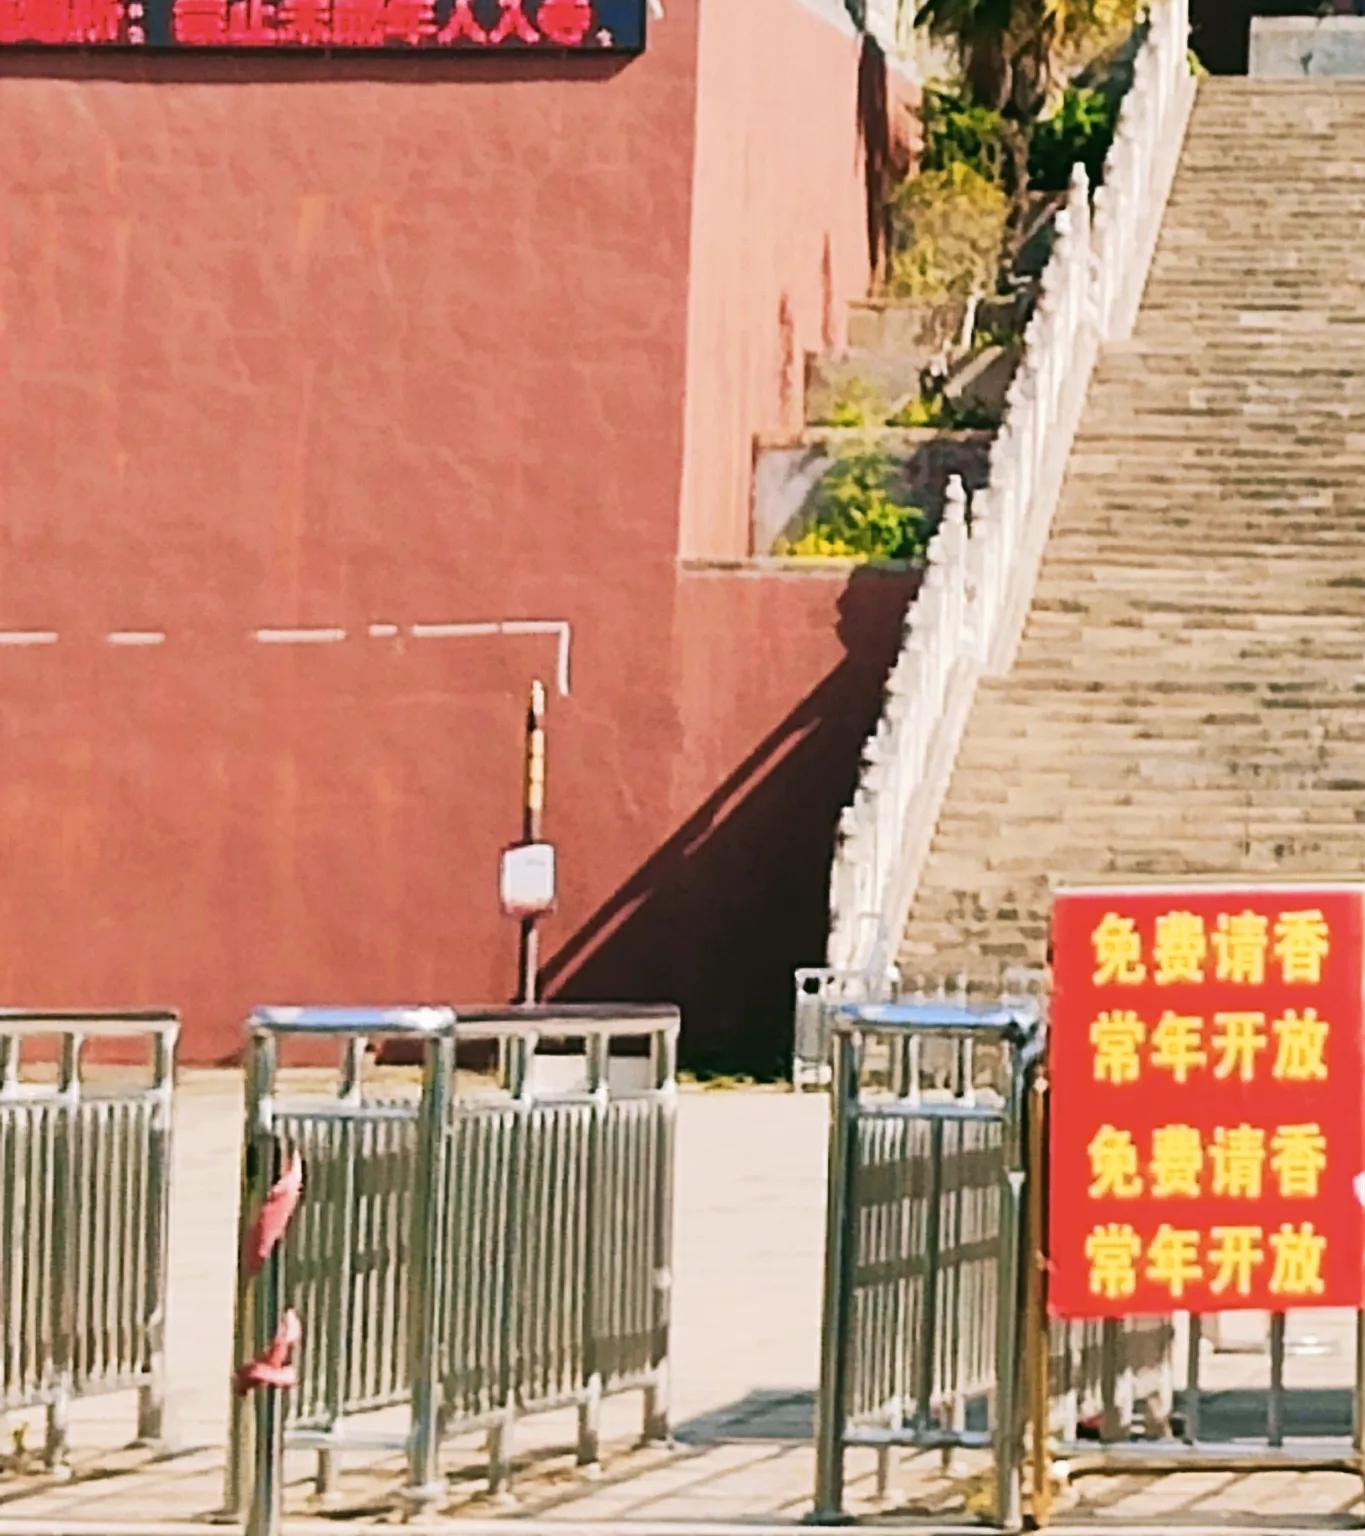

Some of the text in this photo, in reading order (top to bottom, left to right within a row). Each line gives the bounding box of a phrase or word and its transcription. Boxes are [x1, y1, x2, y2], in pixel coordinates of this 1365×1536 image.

[1092, 910, 1330, 985] 免费请香
[1090, 1008, 1330, 1084] 常年开放
[1088, 1124, 1327, 1199] 免费请香
[1086, 1222, 1327, 1300] 常年开放
